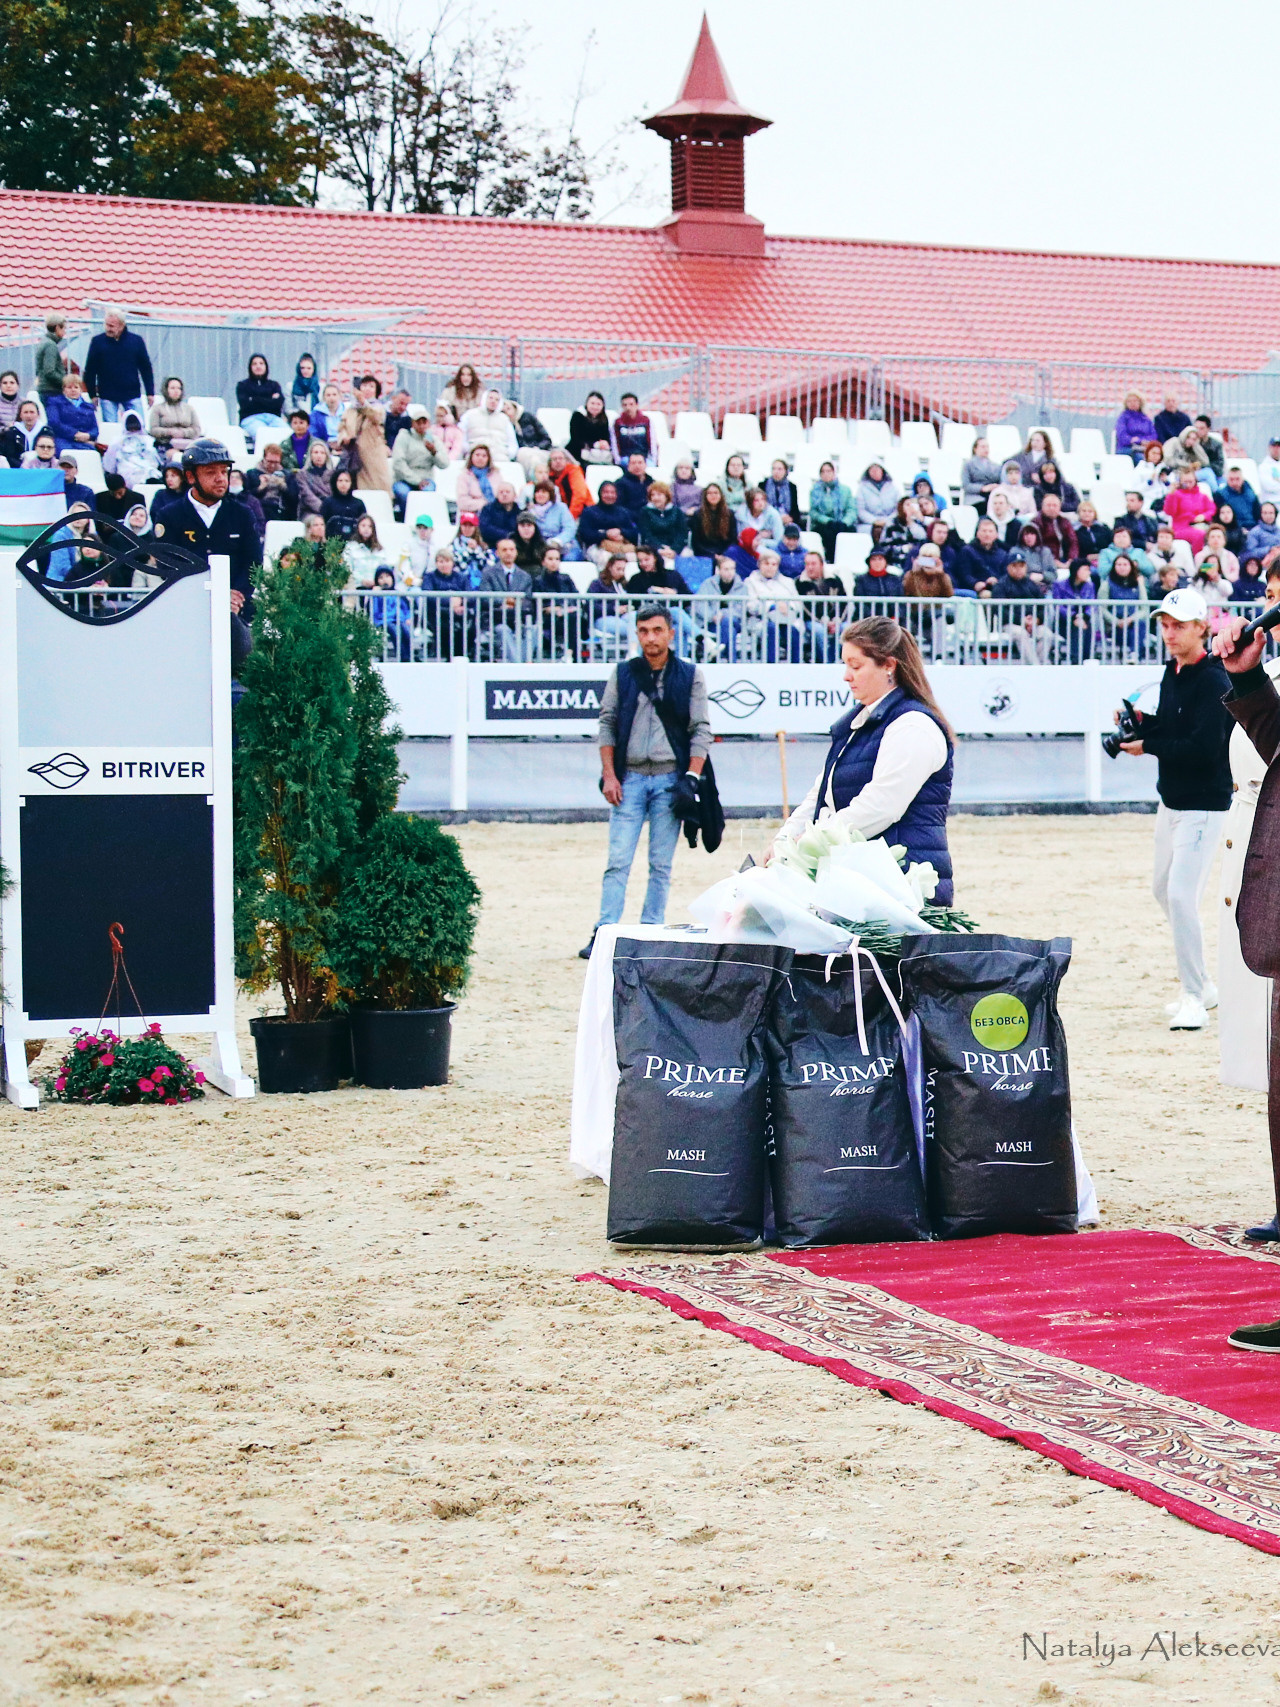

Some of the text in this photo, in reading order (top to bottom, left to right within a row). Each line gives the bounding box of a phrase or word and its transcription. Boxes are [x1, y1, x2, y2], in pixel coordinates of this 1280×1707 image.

[492, 689, 601, 709] MAXIMA
[778, 690, 857, 707] BITRIV
[102, 761, 205, 778] BITRIVER
[975, 1016, 1026, 1028] БЕЗ ОВСА
[643, 1055, 747, 1084] PRIME
[800, 1056, 895, 1084] PRIME
[961, 1047, 1053, 1076] PRIME
[667, 1081, 714, 1099] horse
[829, 1080, 875, 1097] horse
[990, 1074, 1034, 1092] horse
[666, 1149, 706, 1161] MASH
[840, 1145, 878, 1159] MASH
[995, 1141, 1032, 1153] MASH
